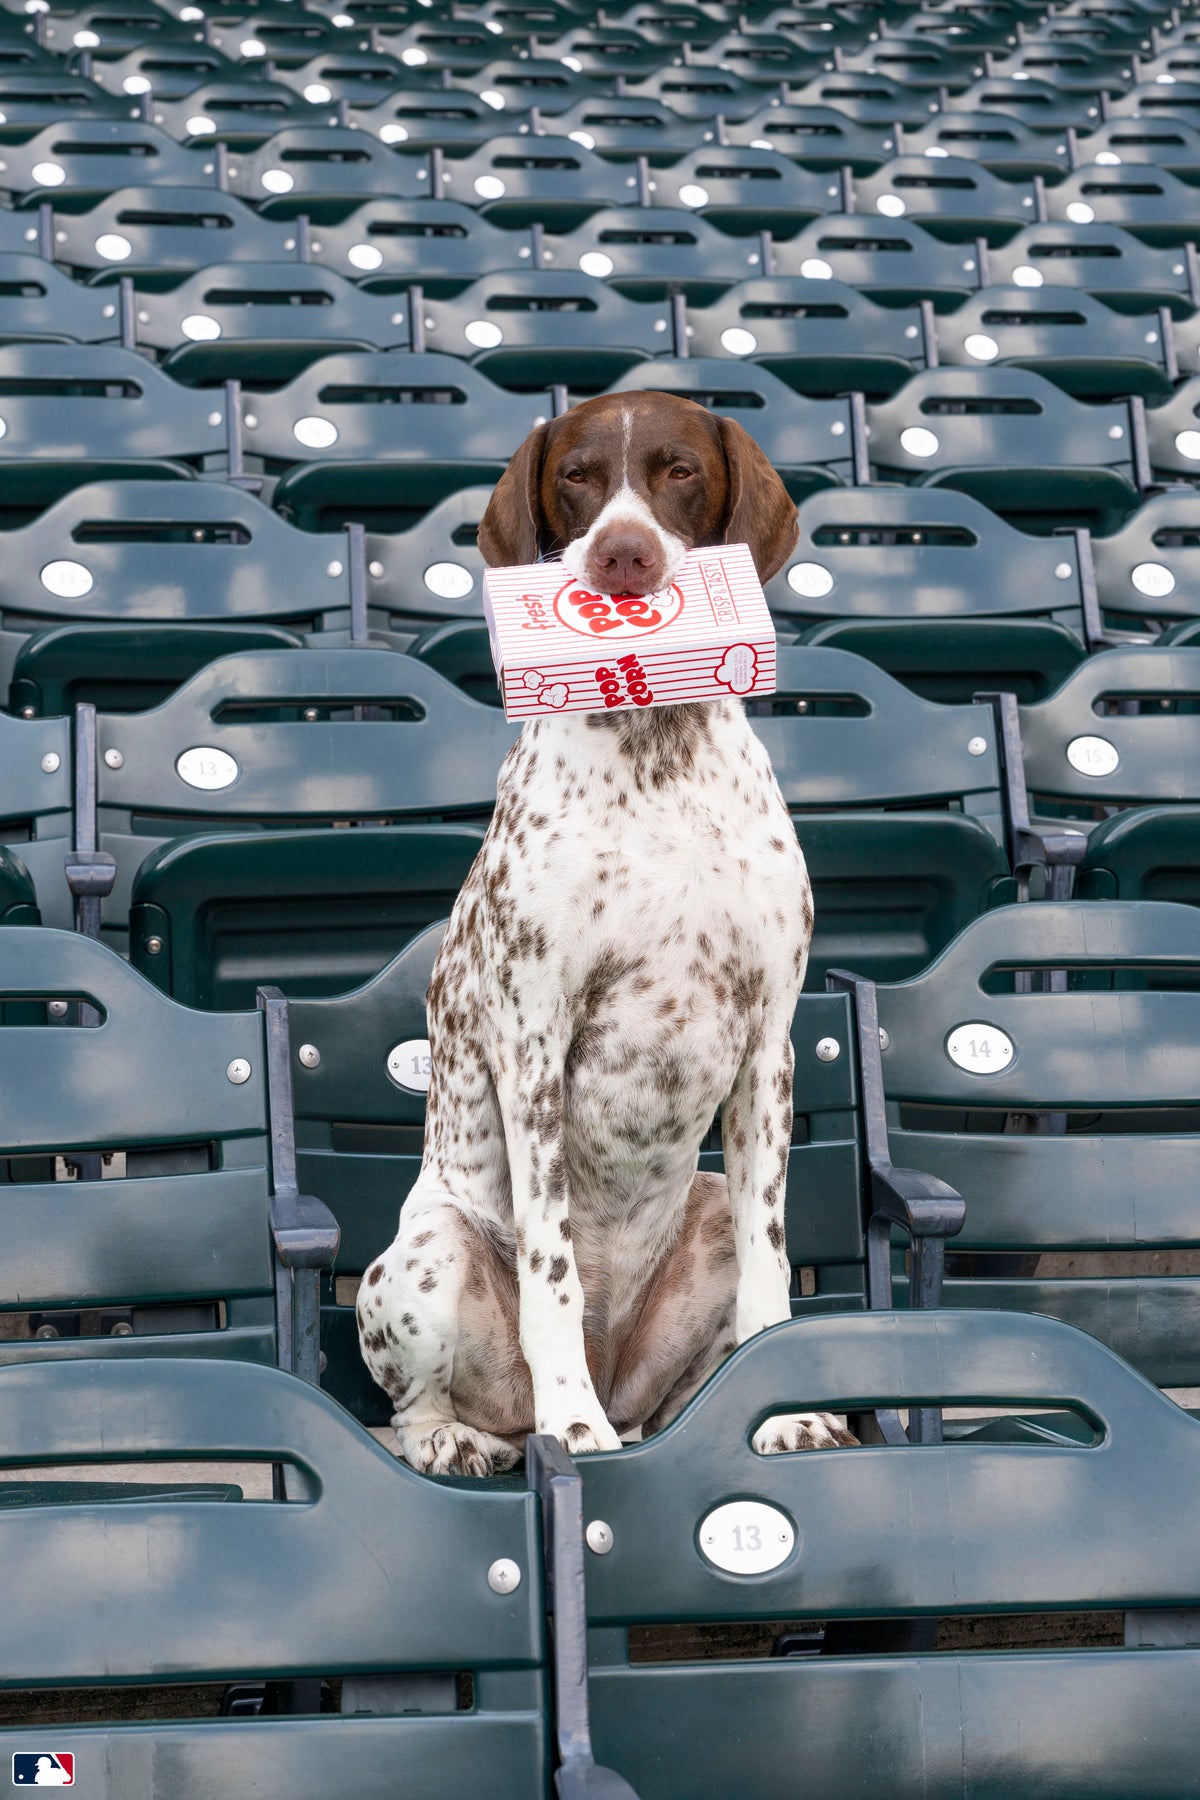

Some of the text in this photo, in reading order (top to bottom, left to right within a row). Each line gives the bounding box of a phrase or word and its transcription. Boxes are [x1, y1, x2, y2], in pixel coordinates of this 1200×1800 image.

[702, 563, 724, 588] TASTY
[515, 594, 557, 630] fresh
[568, 590, 625, 634] POP
[610, 592, 663, 628] CO
[713, 596, 735, 622] CRISP
[594, 666, 626, 708] POP
[616, 653, 654, 706] CORN
[199, 761, 217, 776] 13
[1085, 749, 1101, 764] 15
[969, 1039, 992, 1058] 14
[411, 1055, 432, 1075] 13
[731, 1524, 763, 1552] 13
